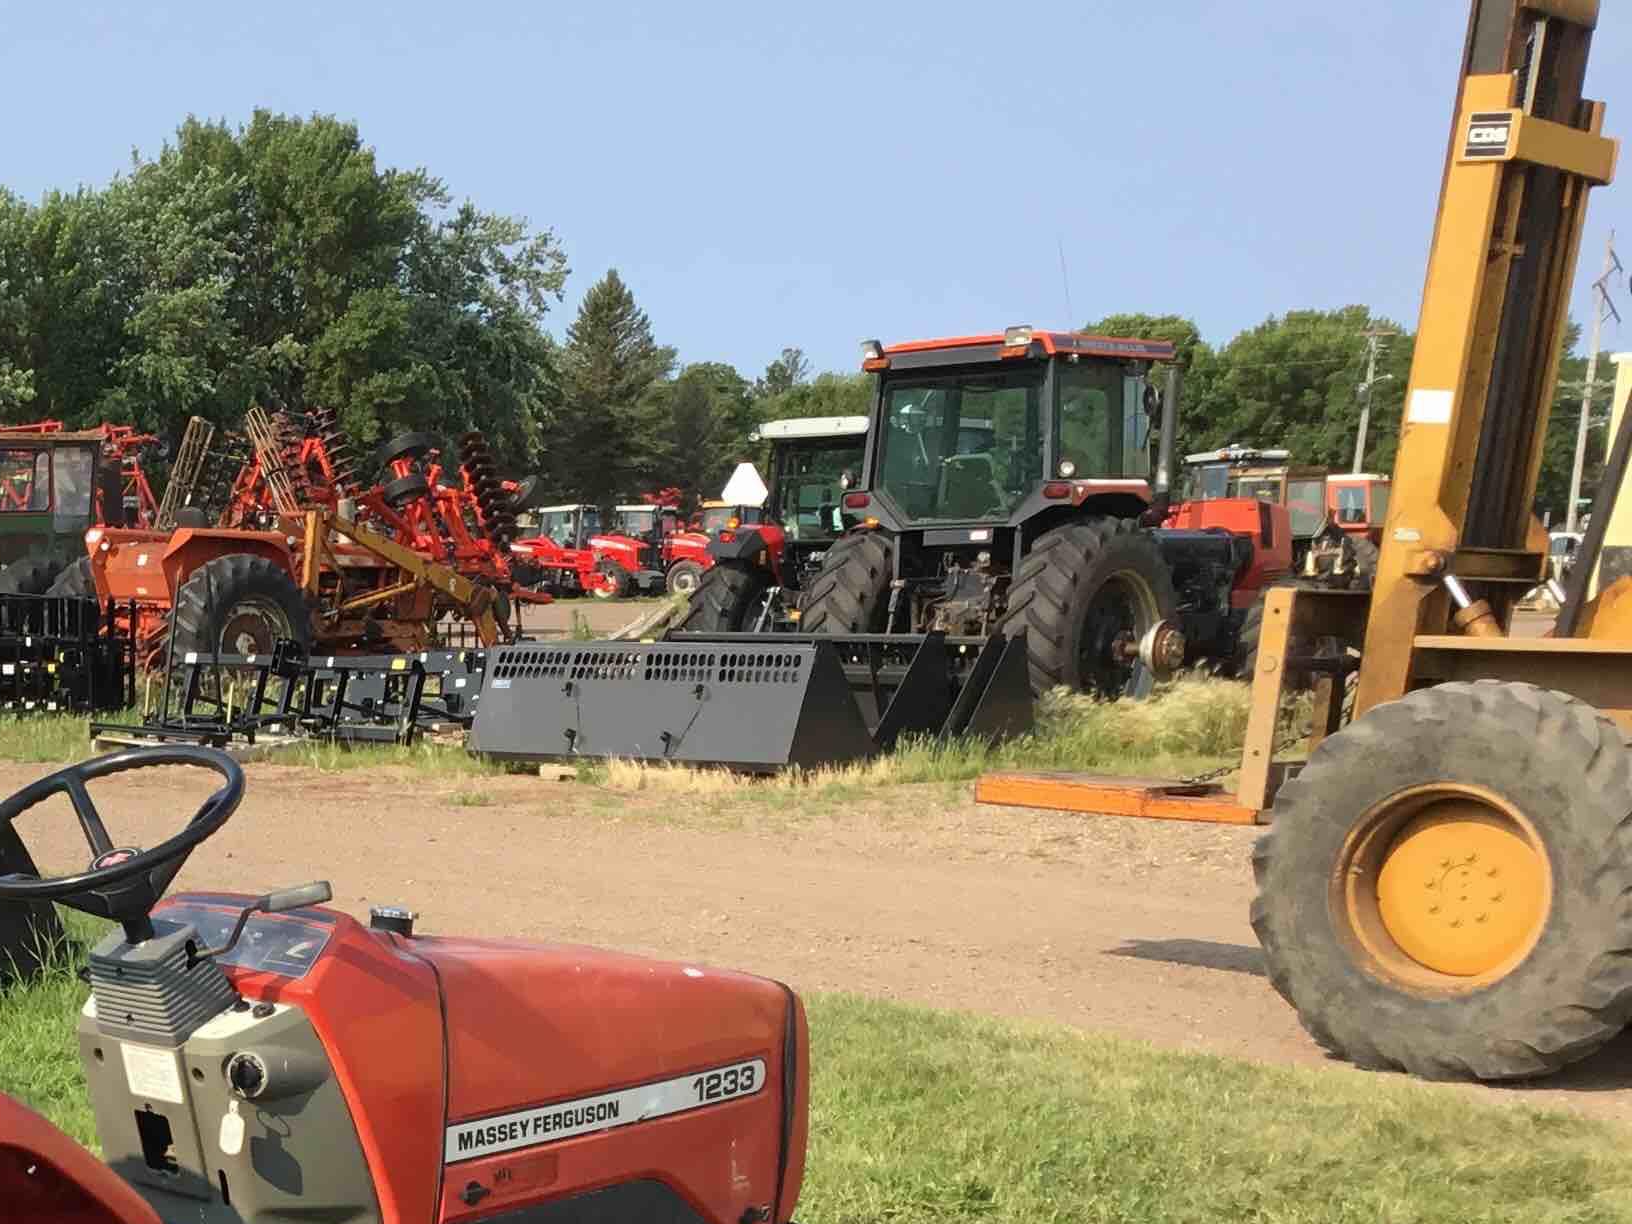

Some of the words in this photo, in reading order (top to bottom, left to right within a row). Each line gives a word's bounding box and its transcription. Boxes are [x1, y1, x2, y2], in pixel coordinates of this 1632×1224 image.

[693, 1065, 755, 1101] 1233
[458, 1118, 530, 1152] MASSEY
[532, 1100, 620, 1134] FERGUSON
